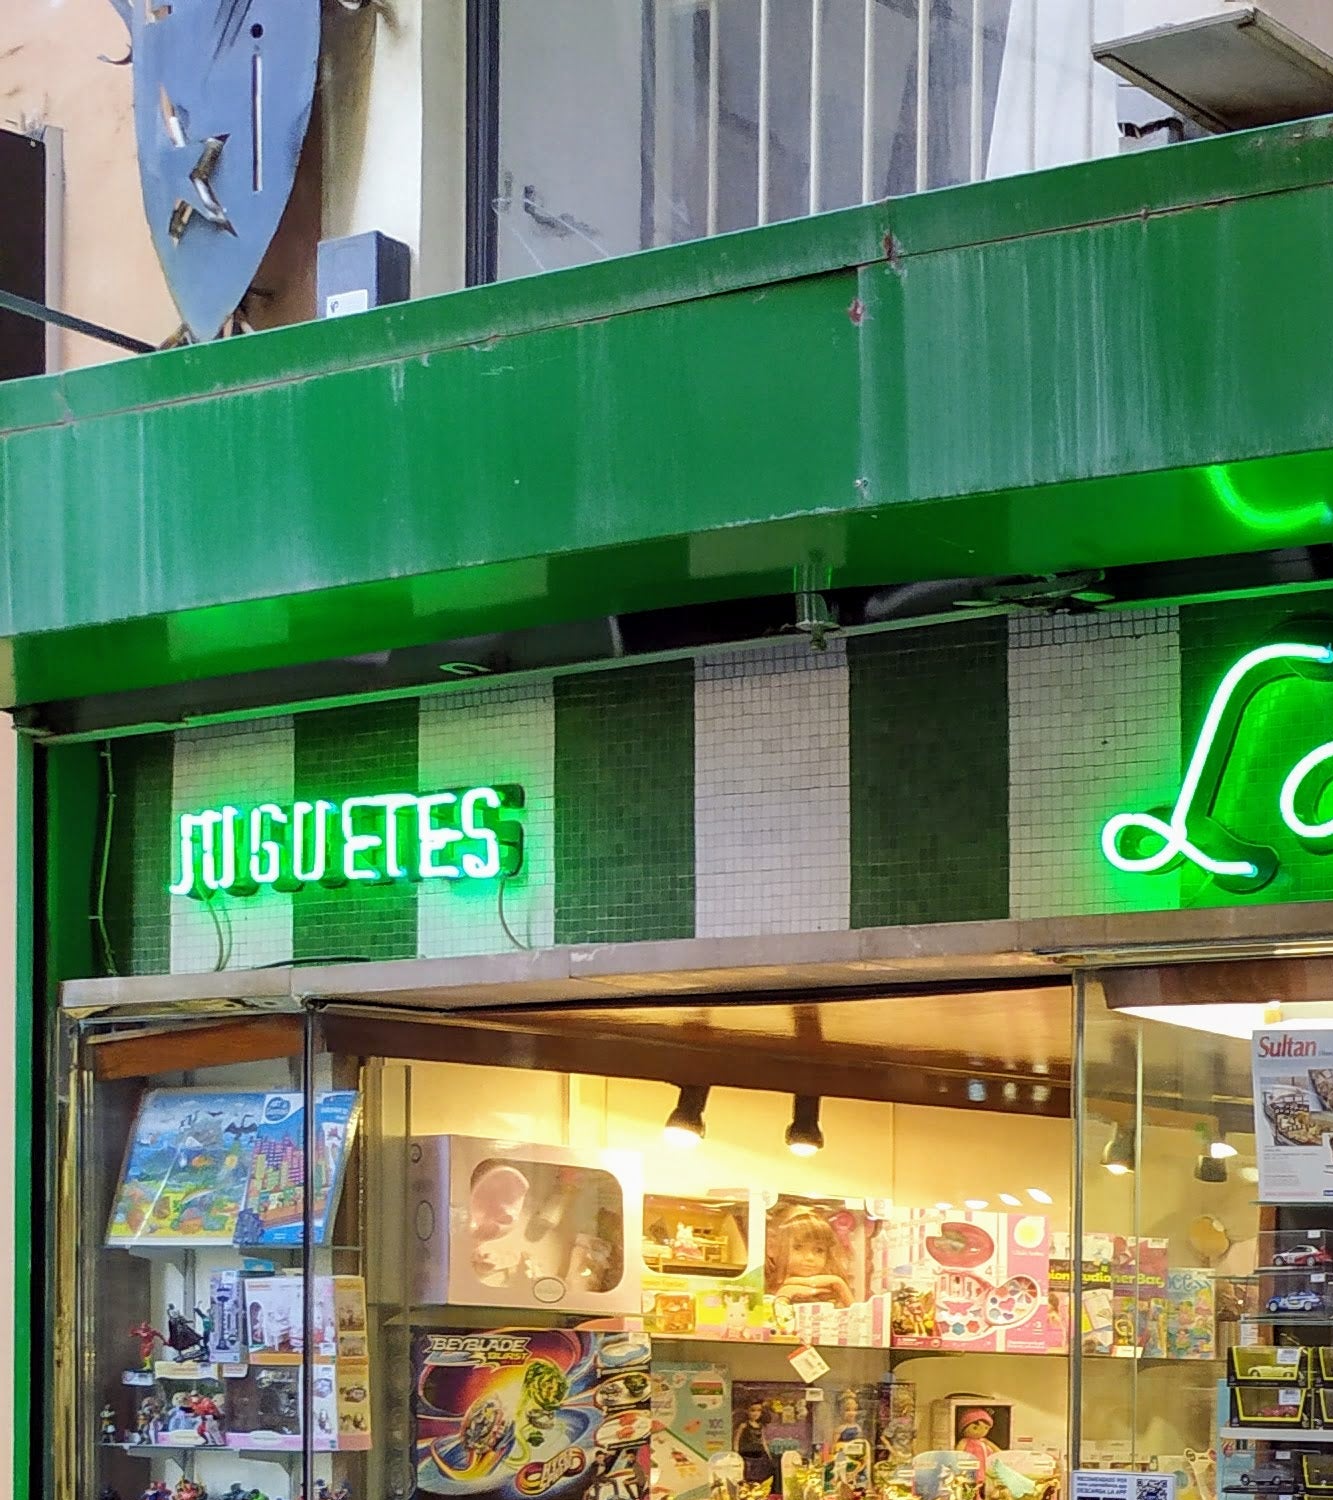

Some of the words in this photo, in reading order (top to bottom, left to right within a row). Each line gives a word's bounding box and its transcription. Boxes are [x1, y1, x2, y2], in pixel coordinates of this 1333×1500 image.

[170, 785, 502, 896] JUGUETES
[1258, 1034, 1317, 1058] Sultan
[431, 1337, 527, 1352] BEYBLADE
